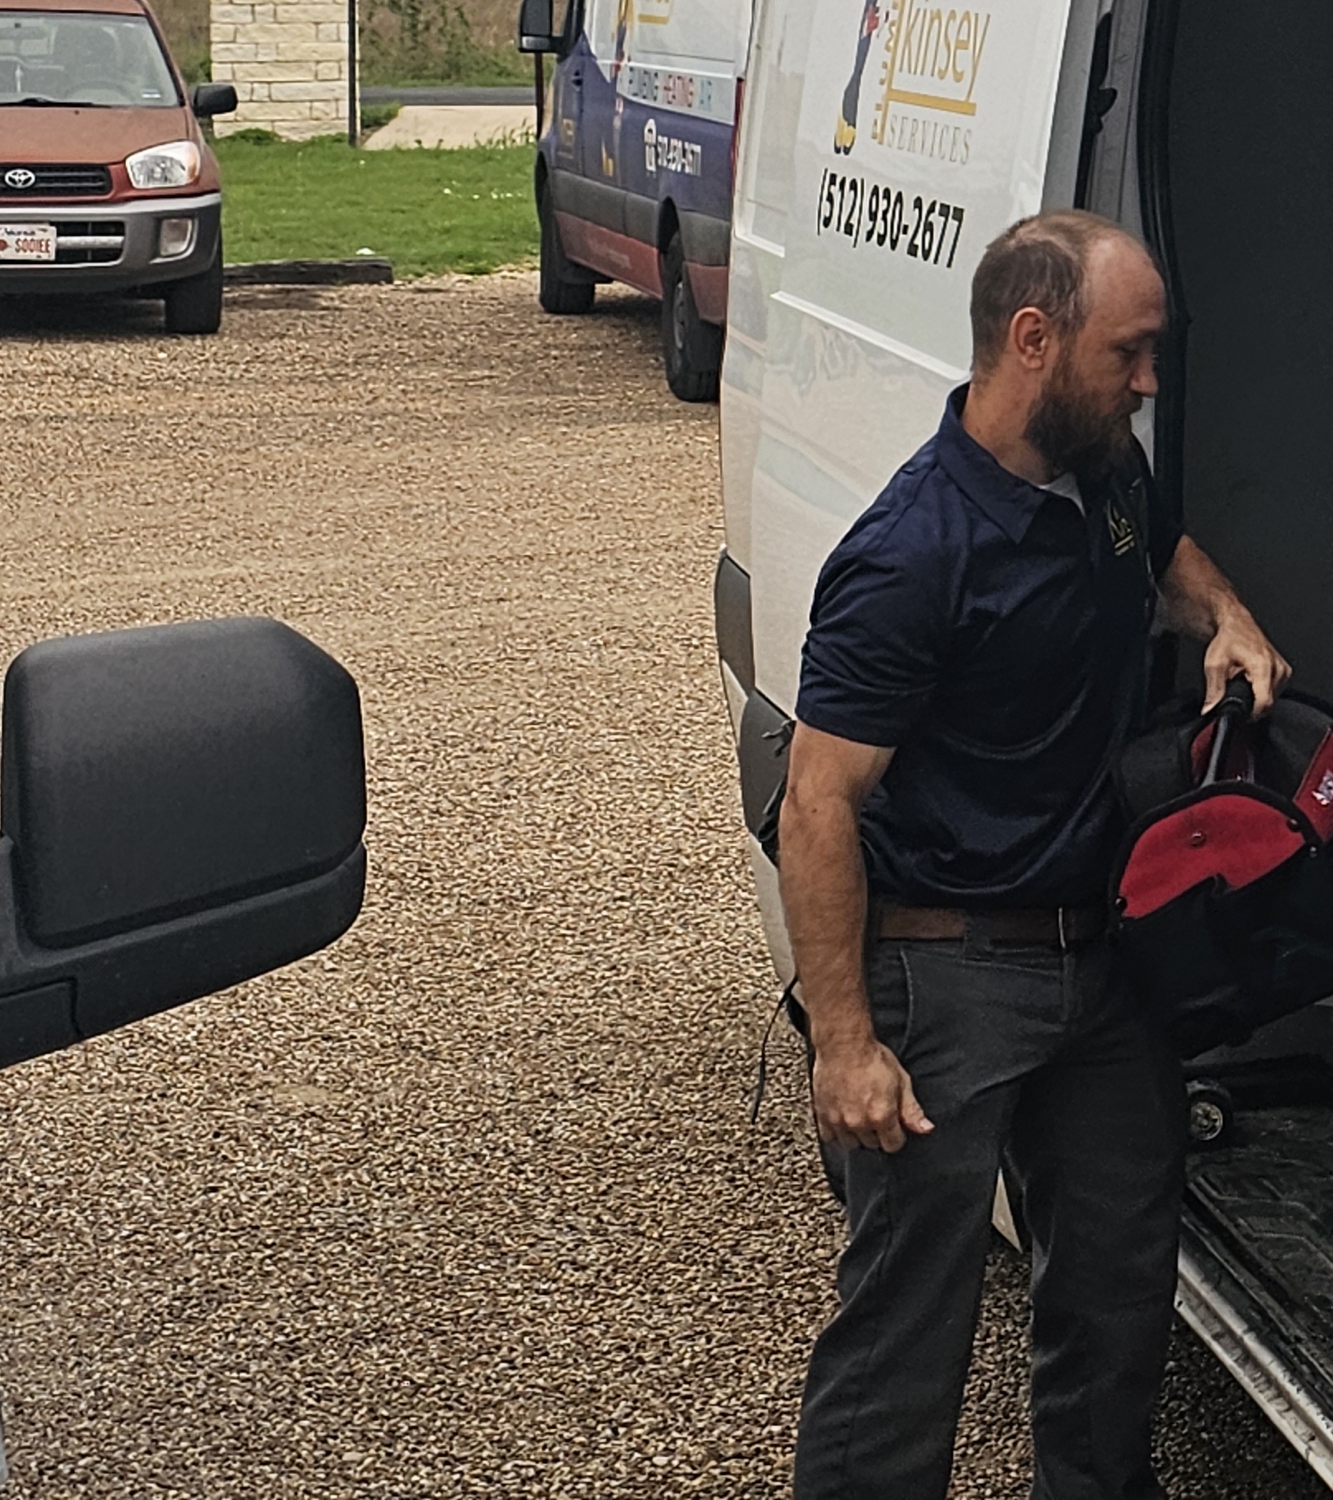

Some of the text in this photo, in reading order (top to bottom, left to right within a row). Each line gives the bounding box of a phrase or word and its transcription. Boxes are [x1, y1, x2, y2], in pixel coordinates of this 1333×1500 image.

[887, 114, 975, 167] SERVICES
[816, 167, 966, 269] (512) 930-2677
